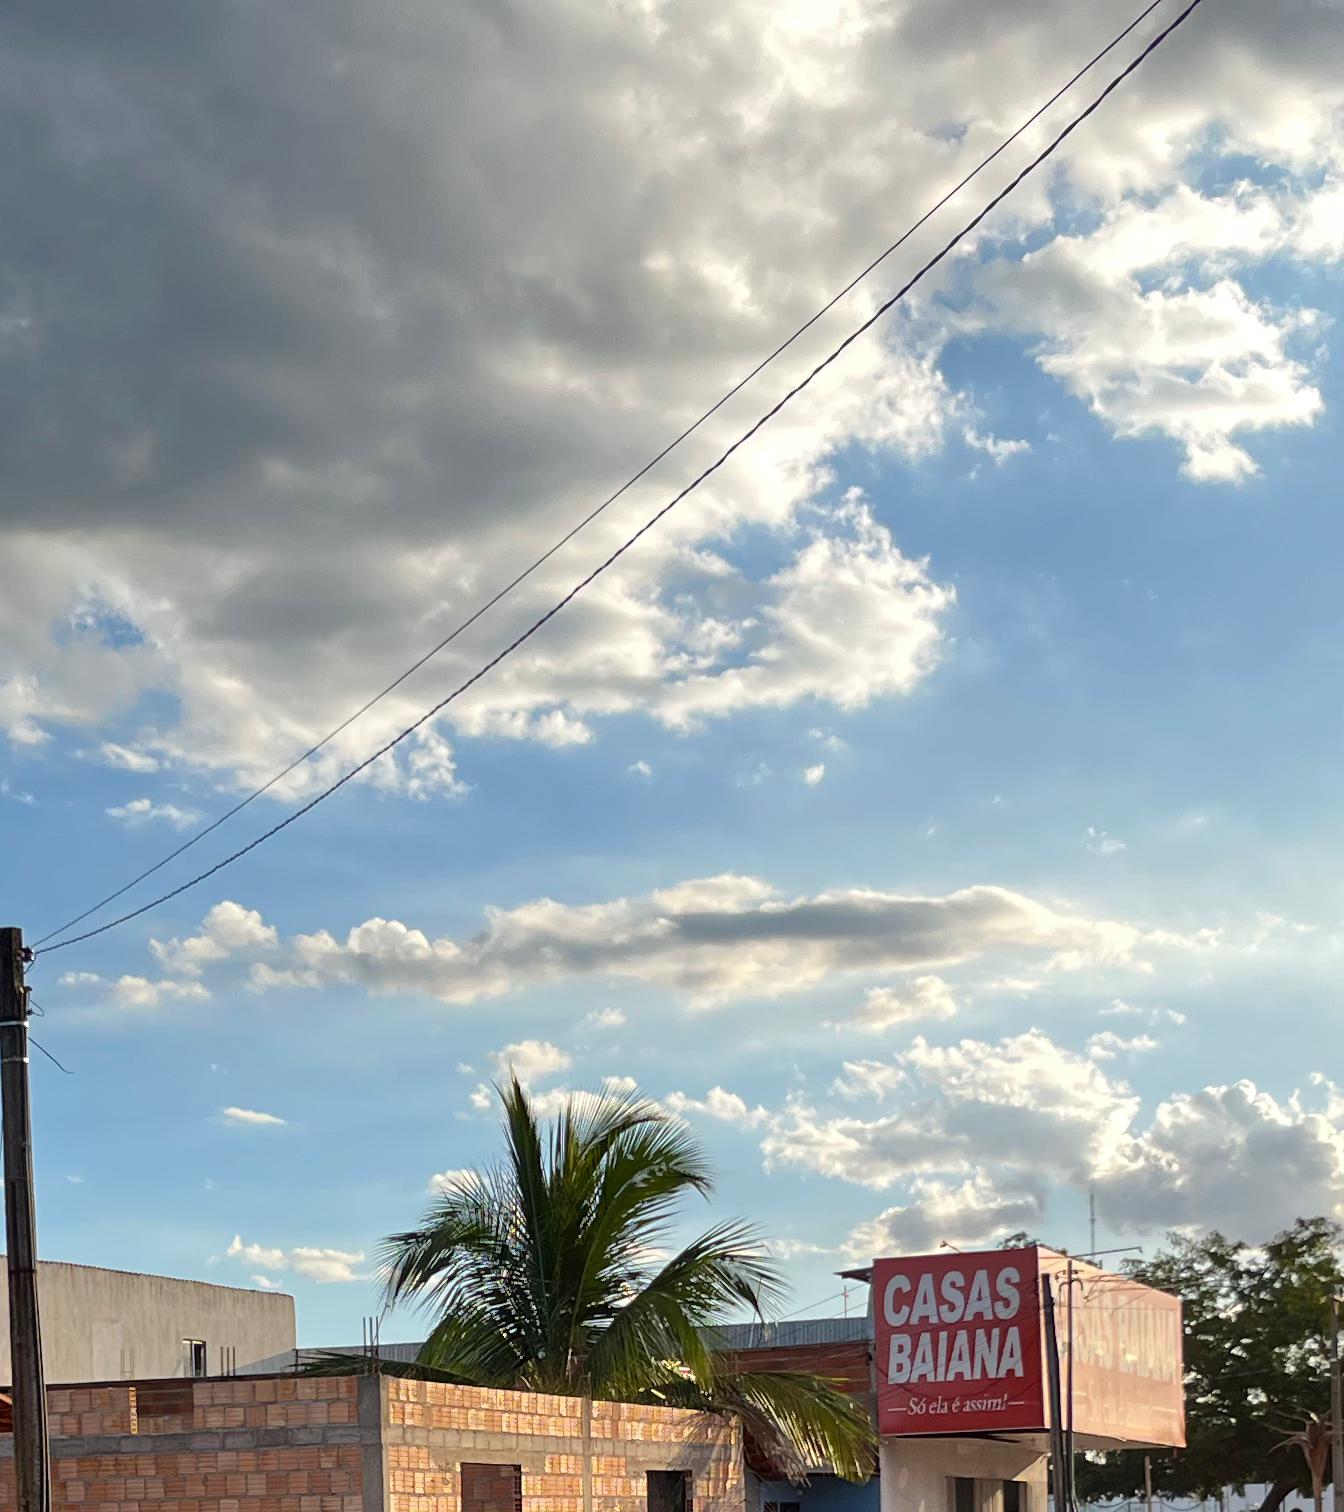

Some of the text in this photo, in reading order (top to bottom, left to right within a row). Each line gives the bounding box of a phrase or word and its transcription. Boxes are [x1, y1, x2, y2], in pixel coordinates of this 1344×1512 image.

[883, 1266, 1021, 1328] CASAS
[888, 1326, 1025, 1385] BAIANA
[907, 1393, 1008, 1415] Só ela é assim!
